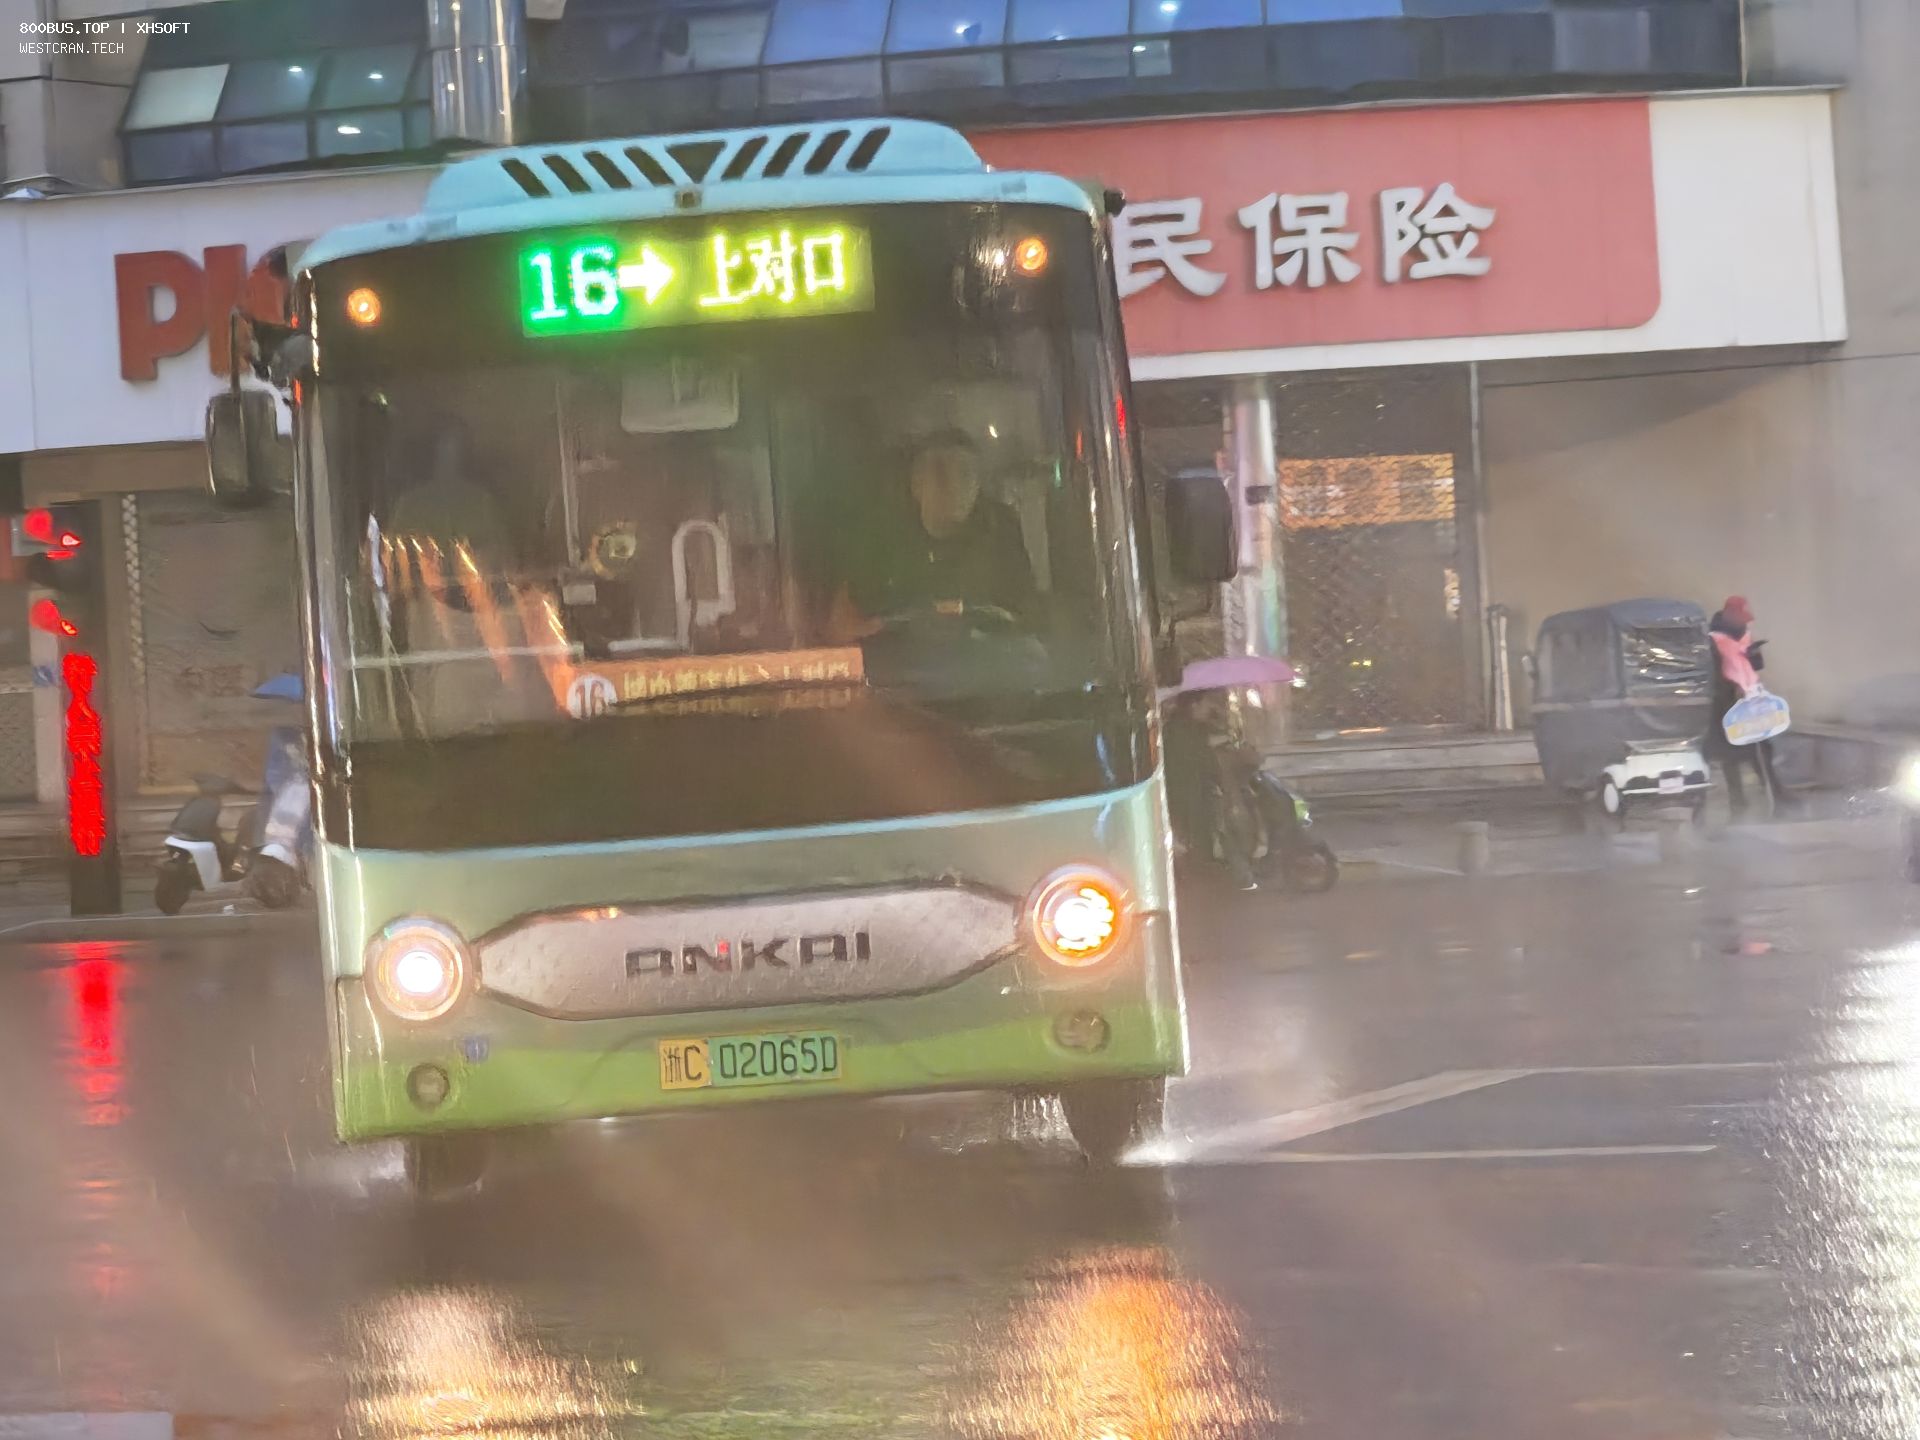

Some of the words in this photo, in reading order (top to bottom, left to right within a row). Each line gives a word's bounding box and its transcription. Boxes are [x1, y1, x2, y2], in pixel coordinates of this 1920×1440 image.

[530, 246, 620, 320] 16
[699, 230, 846, 305] 上对口
[1112, 182, 1496, 299] 民保险
[625, 931, 871, 977] ANKAI
